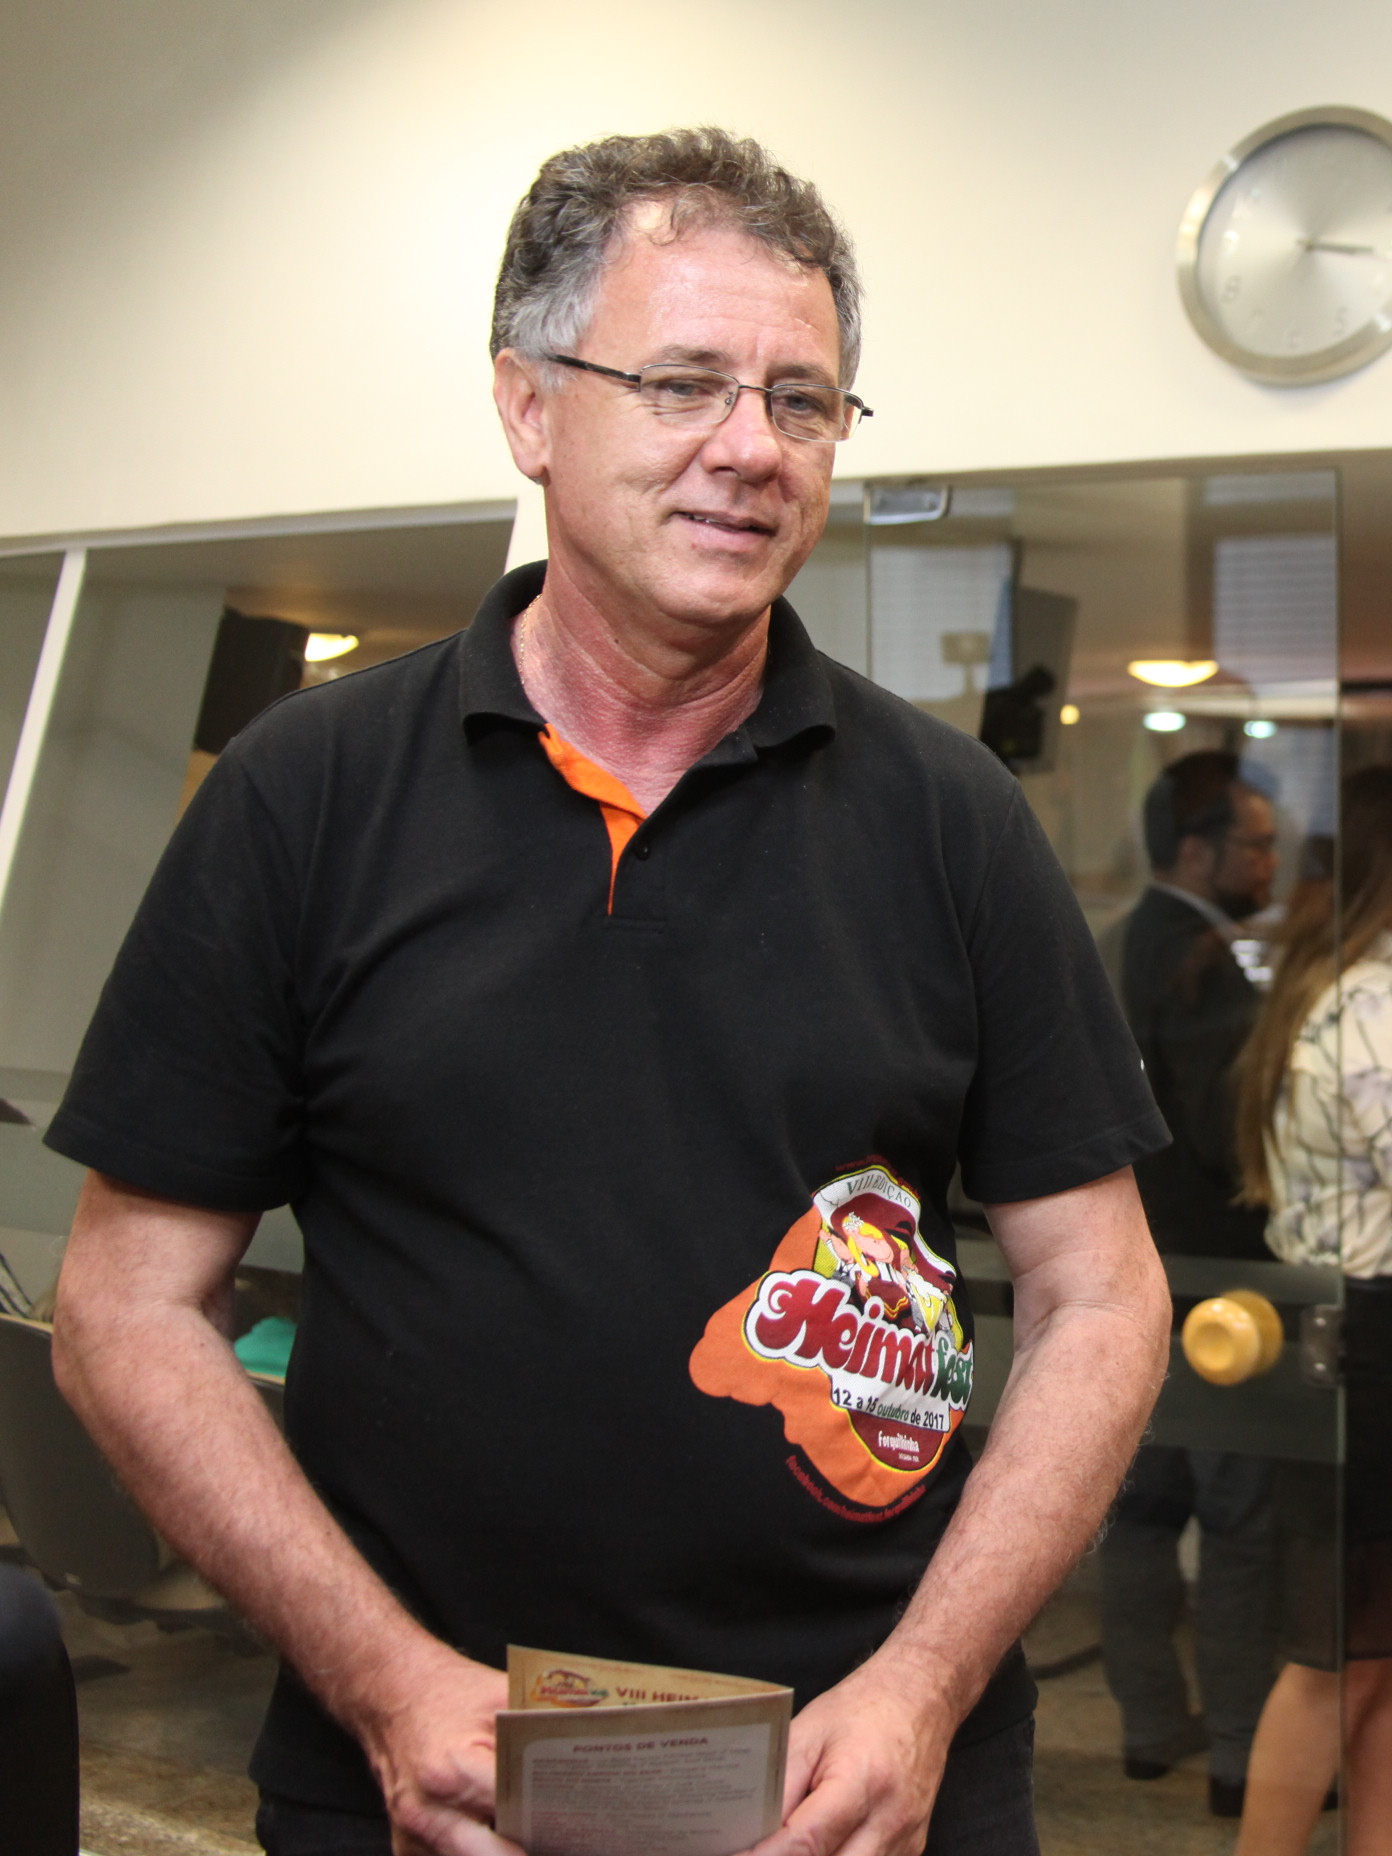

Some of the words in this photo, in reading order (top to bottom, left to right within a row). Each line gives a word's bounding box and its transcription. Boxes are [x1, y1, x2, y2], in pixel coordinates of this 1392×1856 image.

[754, 1278, 973, 1405] Heimatfest
[833, 1387, 852, 1407] 12
[857, 1397, 864, 1410] a
[866, 1396, 880, 1413] 15
[877, 1402, 909, 1421] outubro
[911, 1408, 921, 1426] de
[923, 1411, 945, 1430] 2017
[636, 1740, 655, 1750] DE
